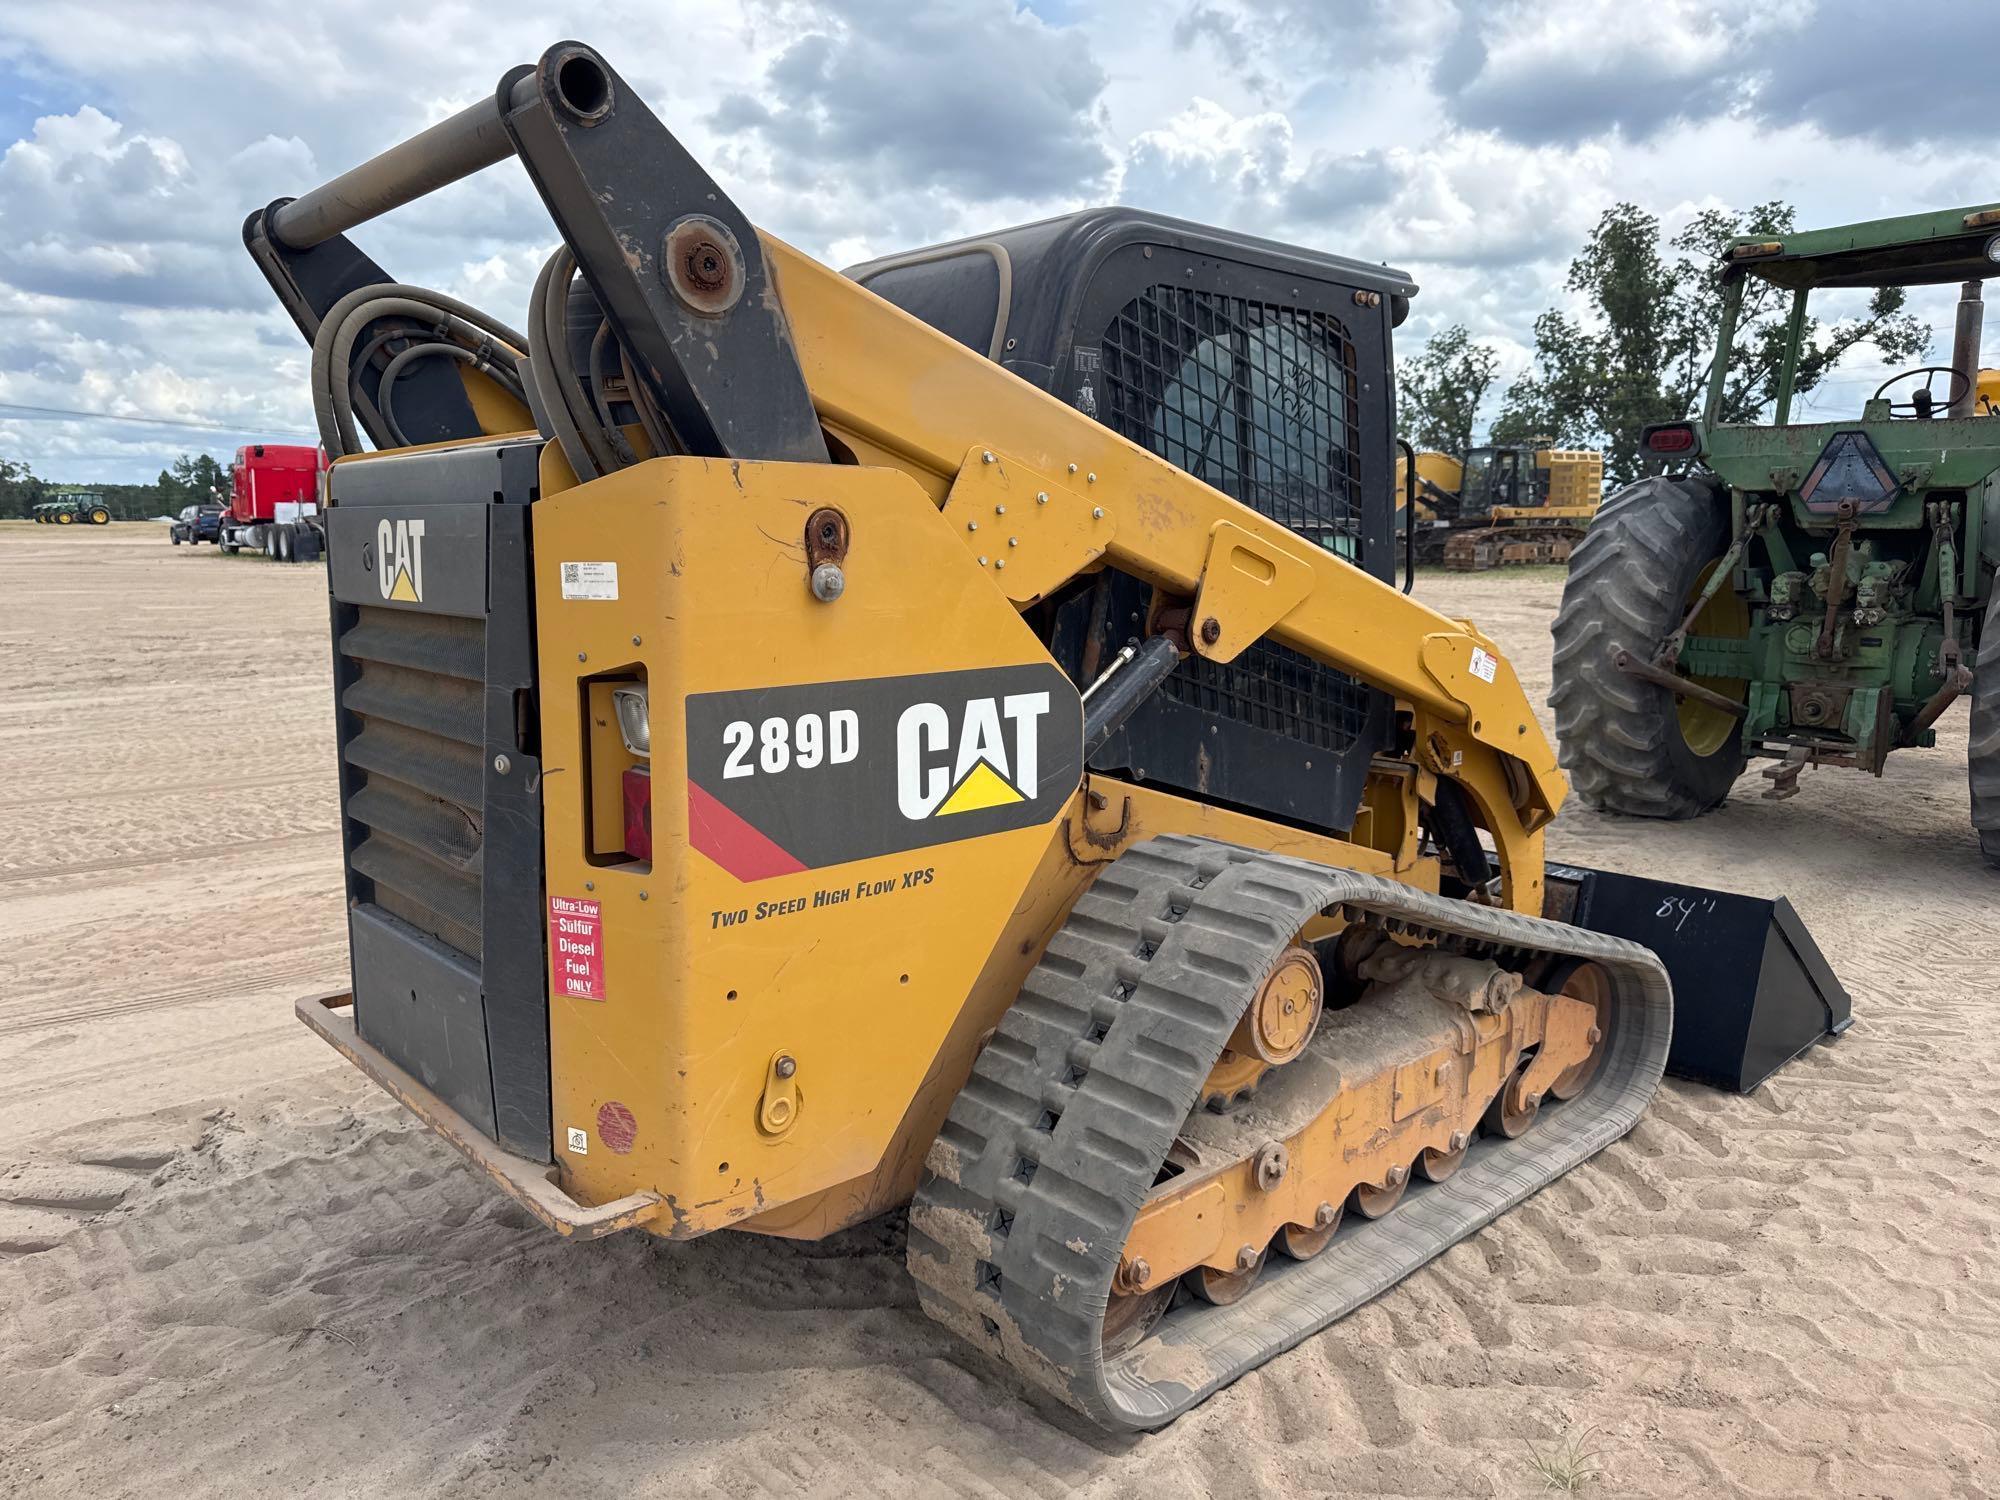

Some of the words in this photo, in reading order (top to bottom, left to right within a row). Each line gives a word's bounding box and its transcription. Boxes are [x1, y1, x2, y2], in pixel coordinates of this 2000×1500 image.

[378, 519, 425, 602] CAT
[723, 709, 859, 779] 289D
[897, 691, 1050, 821] CAT
[901, 867, 935, 889] XPS
[552, 897, 598, 915] Ultra-Low
[559, 917, 593, 936] Sulfur
[559, 937, 595, 956] Diesel
[566, 958, 589, 976] Fuel
[566, 978, 592, 992] ONLY
